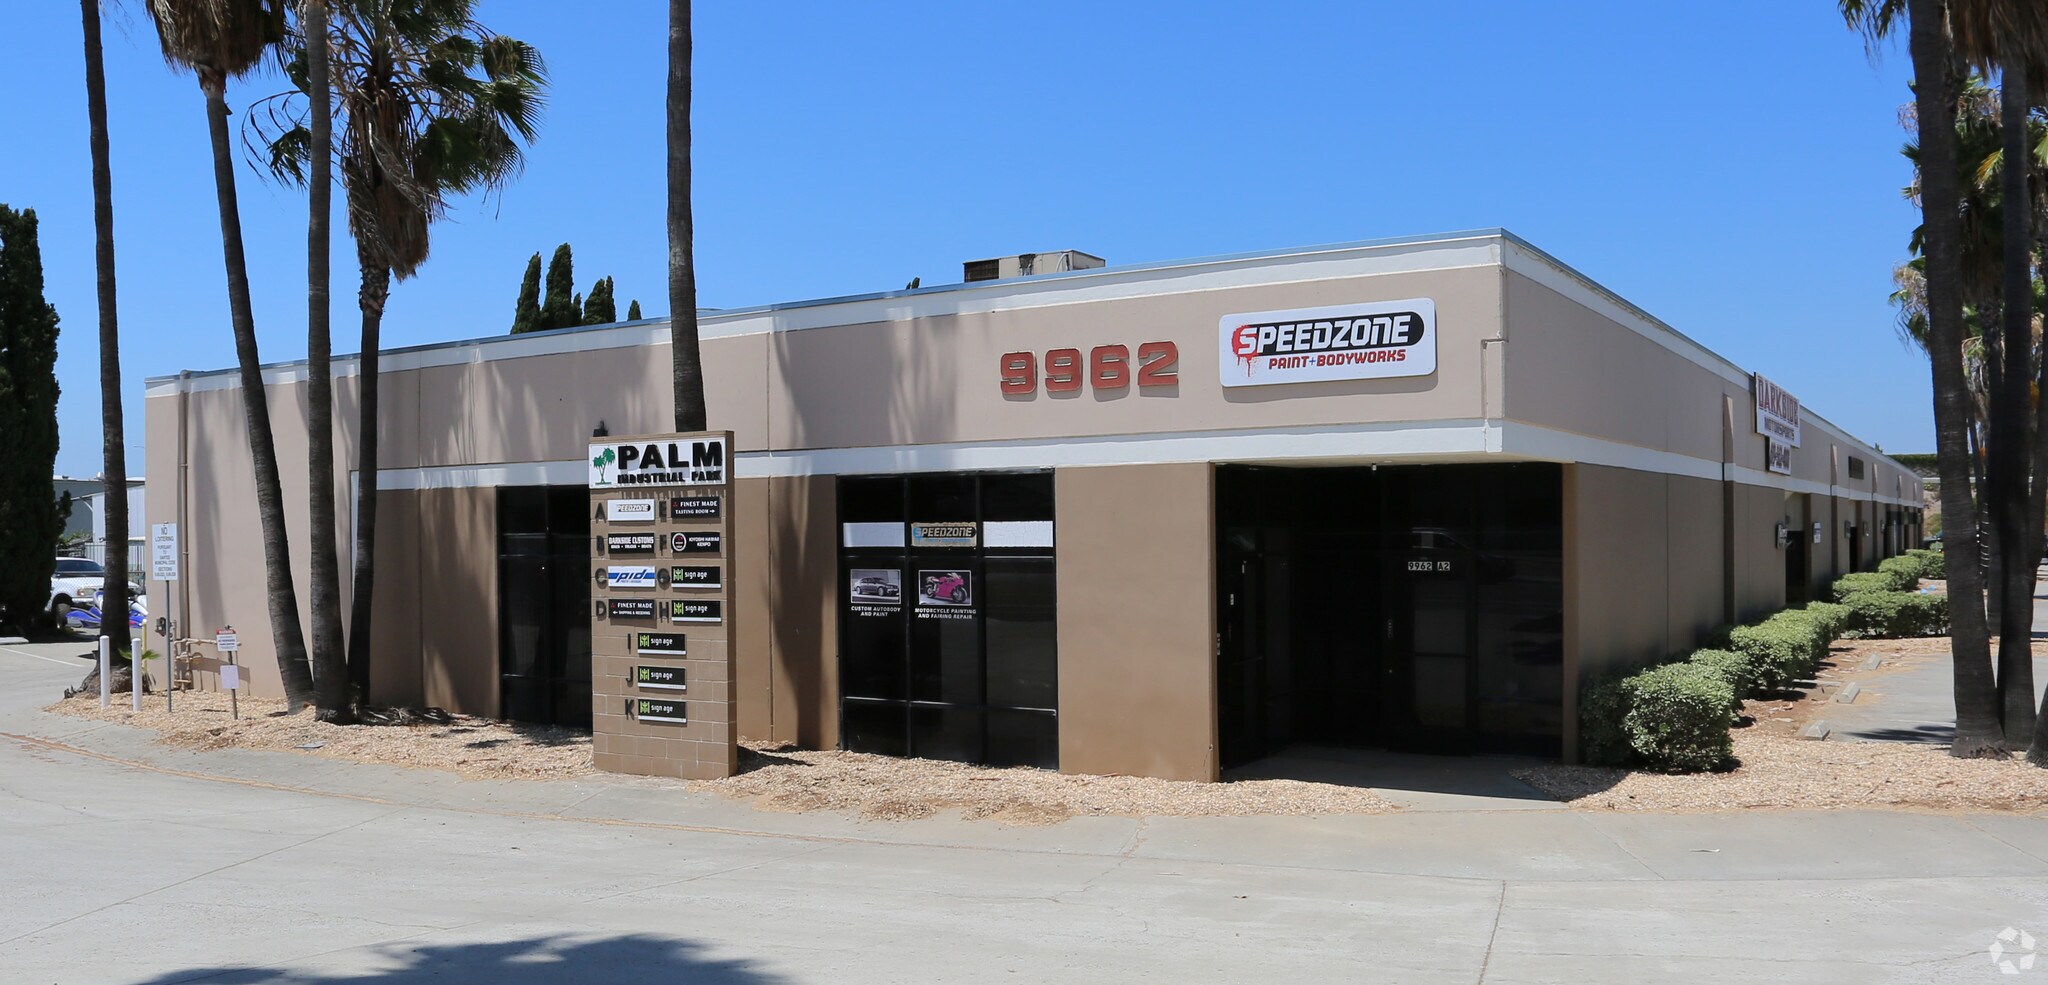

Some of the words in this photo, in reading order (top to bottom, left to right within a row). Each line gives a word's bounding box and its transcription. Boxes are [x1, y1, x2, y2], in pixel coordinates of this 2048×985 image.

[1235, 314, 1411, 355] SPEEDZONE
[1000, 340, 1179, 394] 9962
[1757, 375, 1799, 428] DARKSIDE
[617, 441, 723, 470] PALM
[617, 471, 686, 484] INDUSTRIAL
[691, 470, 722, 481] PARK
[595, 502, 606, 520] A
[659, 501, 667, 518] E
[161, 527, 168, 535] NO
[913, 527, 973, 537] SPEEDZONE
[608, 536, 632, 545] DARKSIDE
[632, 536, 654, 544] CUSTOMS
[1409, 562, 1432, 570] 9962
[1438, 562, 1449, 570] A2
[684, 571, 696, 580] sign
[596, 600, 606, 617] D
[659, 601, 669, 619] H
[684, 605, 697, 613] sign
[650, 637, 662, 645] sign
[625, 666, 634, 683] J
[650, 671, 662, 679] sign
[624, 698, 635, 716] K
[650, 704, 662, 712] sign
